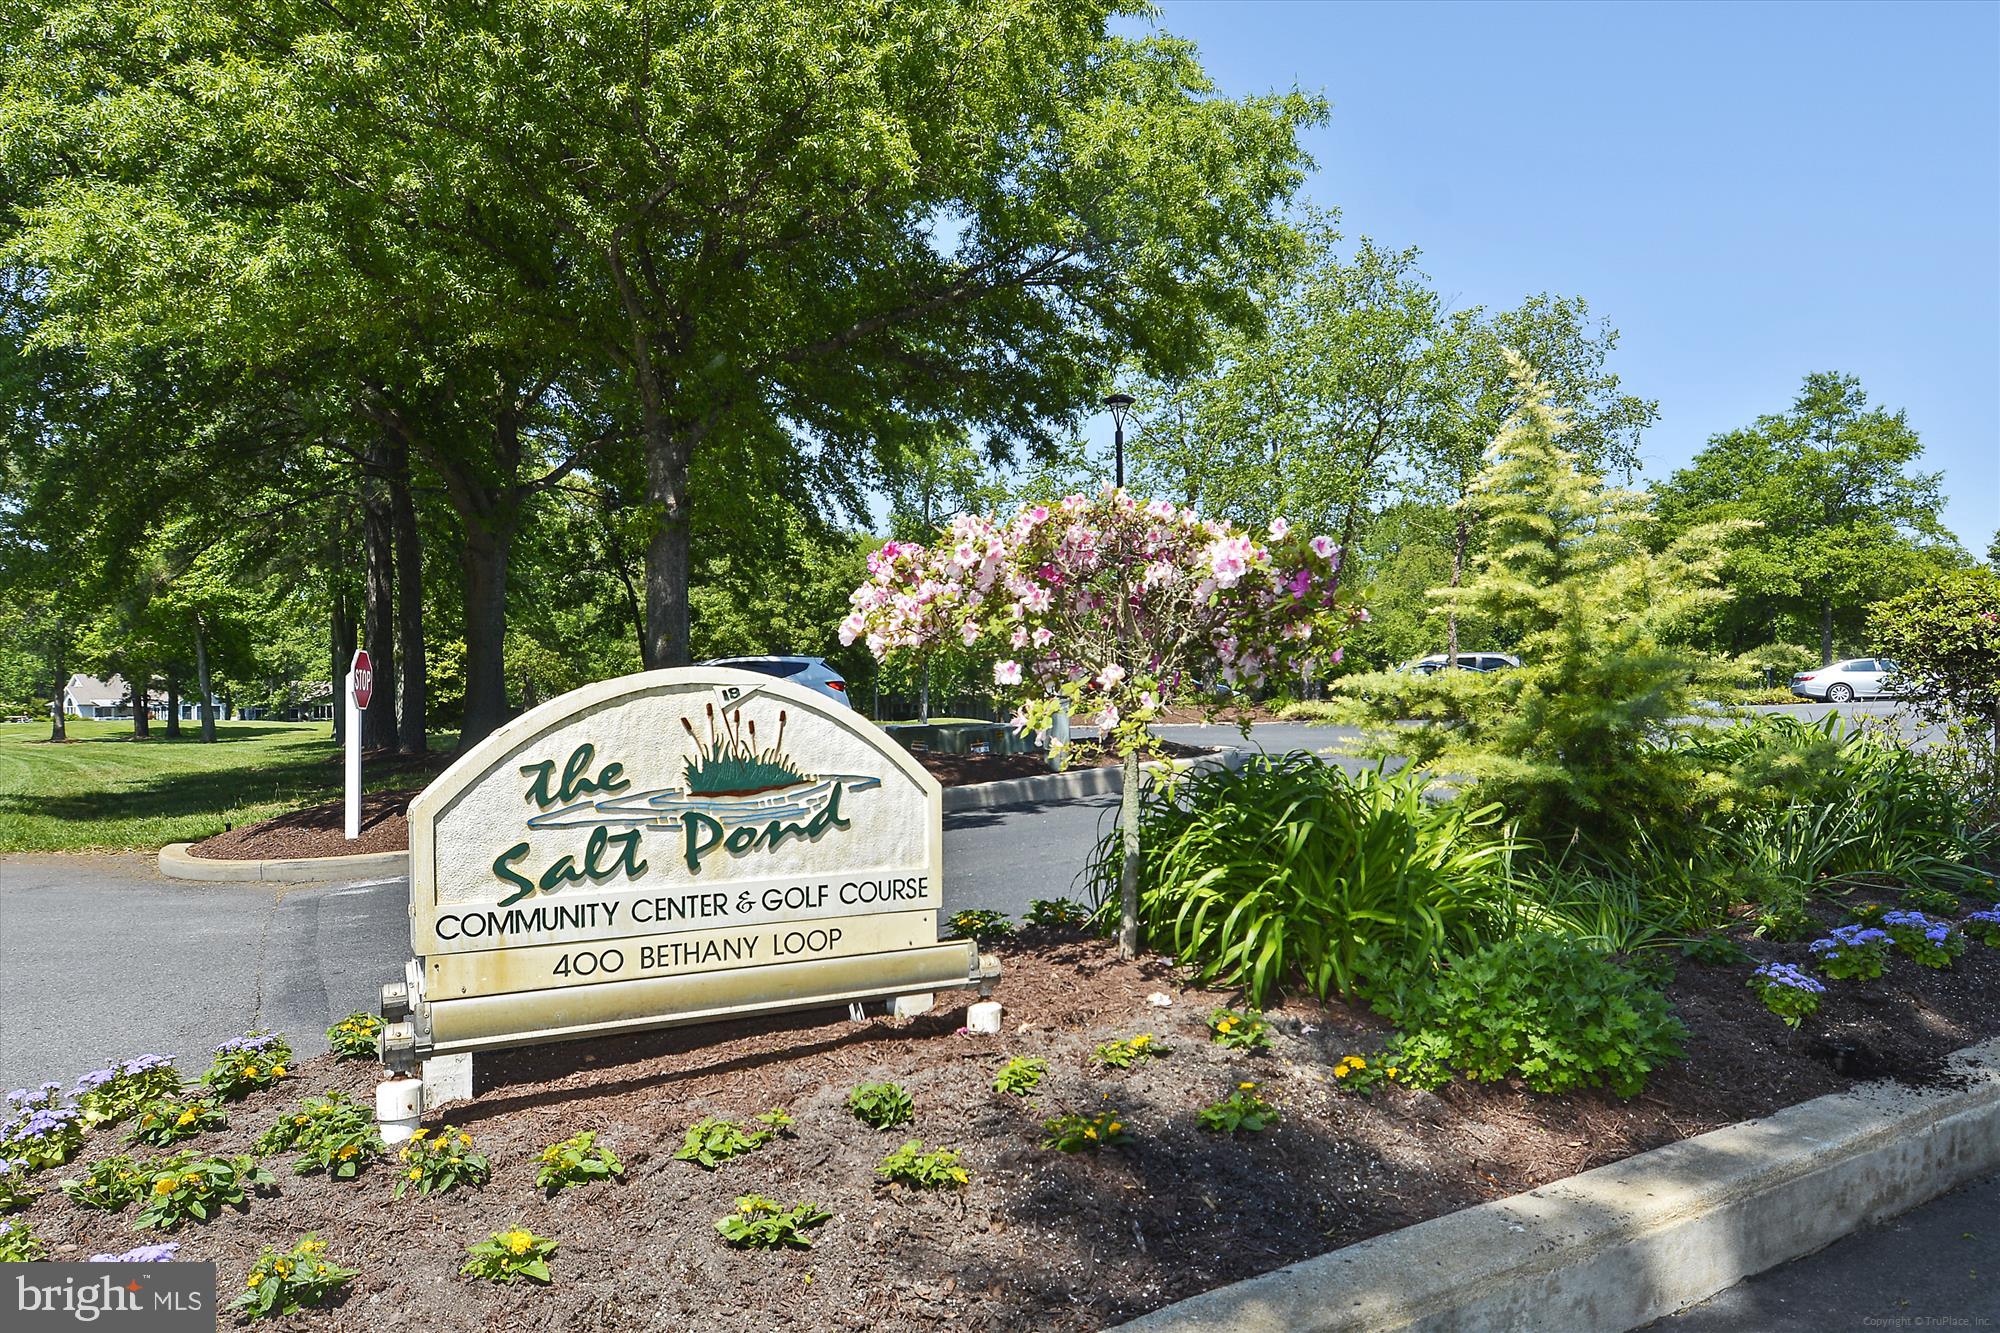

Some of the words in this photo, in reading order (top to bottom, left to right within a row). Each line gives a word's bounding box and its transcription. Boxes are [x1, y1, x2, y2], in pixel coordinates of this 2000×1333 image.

[355, 669, 371, 691] STOP
[519, 742, 632, 808] the
[492, 825, 649, 907] Salt
[682, 781, 851, 872] Pond
[435, 901, 620, 940] COMMUNITY
[631, 892, 729, 923] CENTER
[735, 890, 757, 914] &
[761, 884, 829, 911] GOLF
[839, 877, 929, 905] COURSE
[552, 949, 624, 977] 400
[640, 935, 760, 970] BETHANY
[773, 928, 843, 956] LOOP
